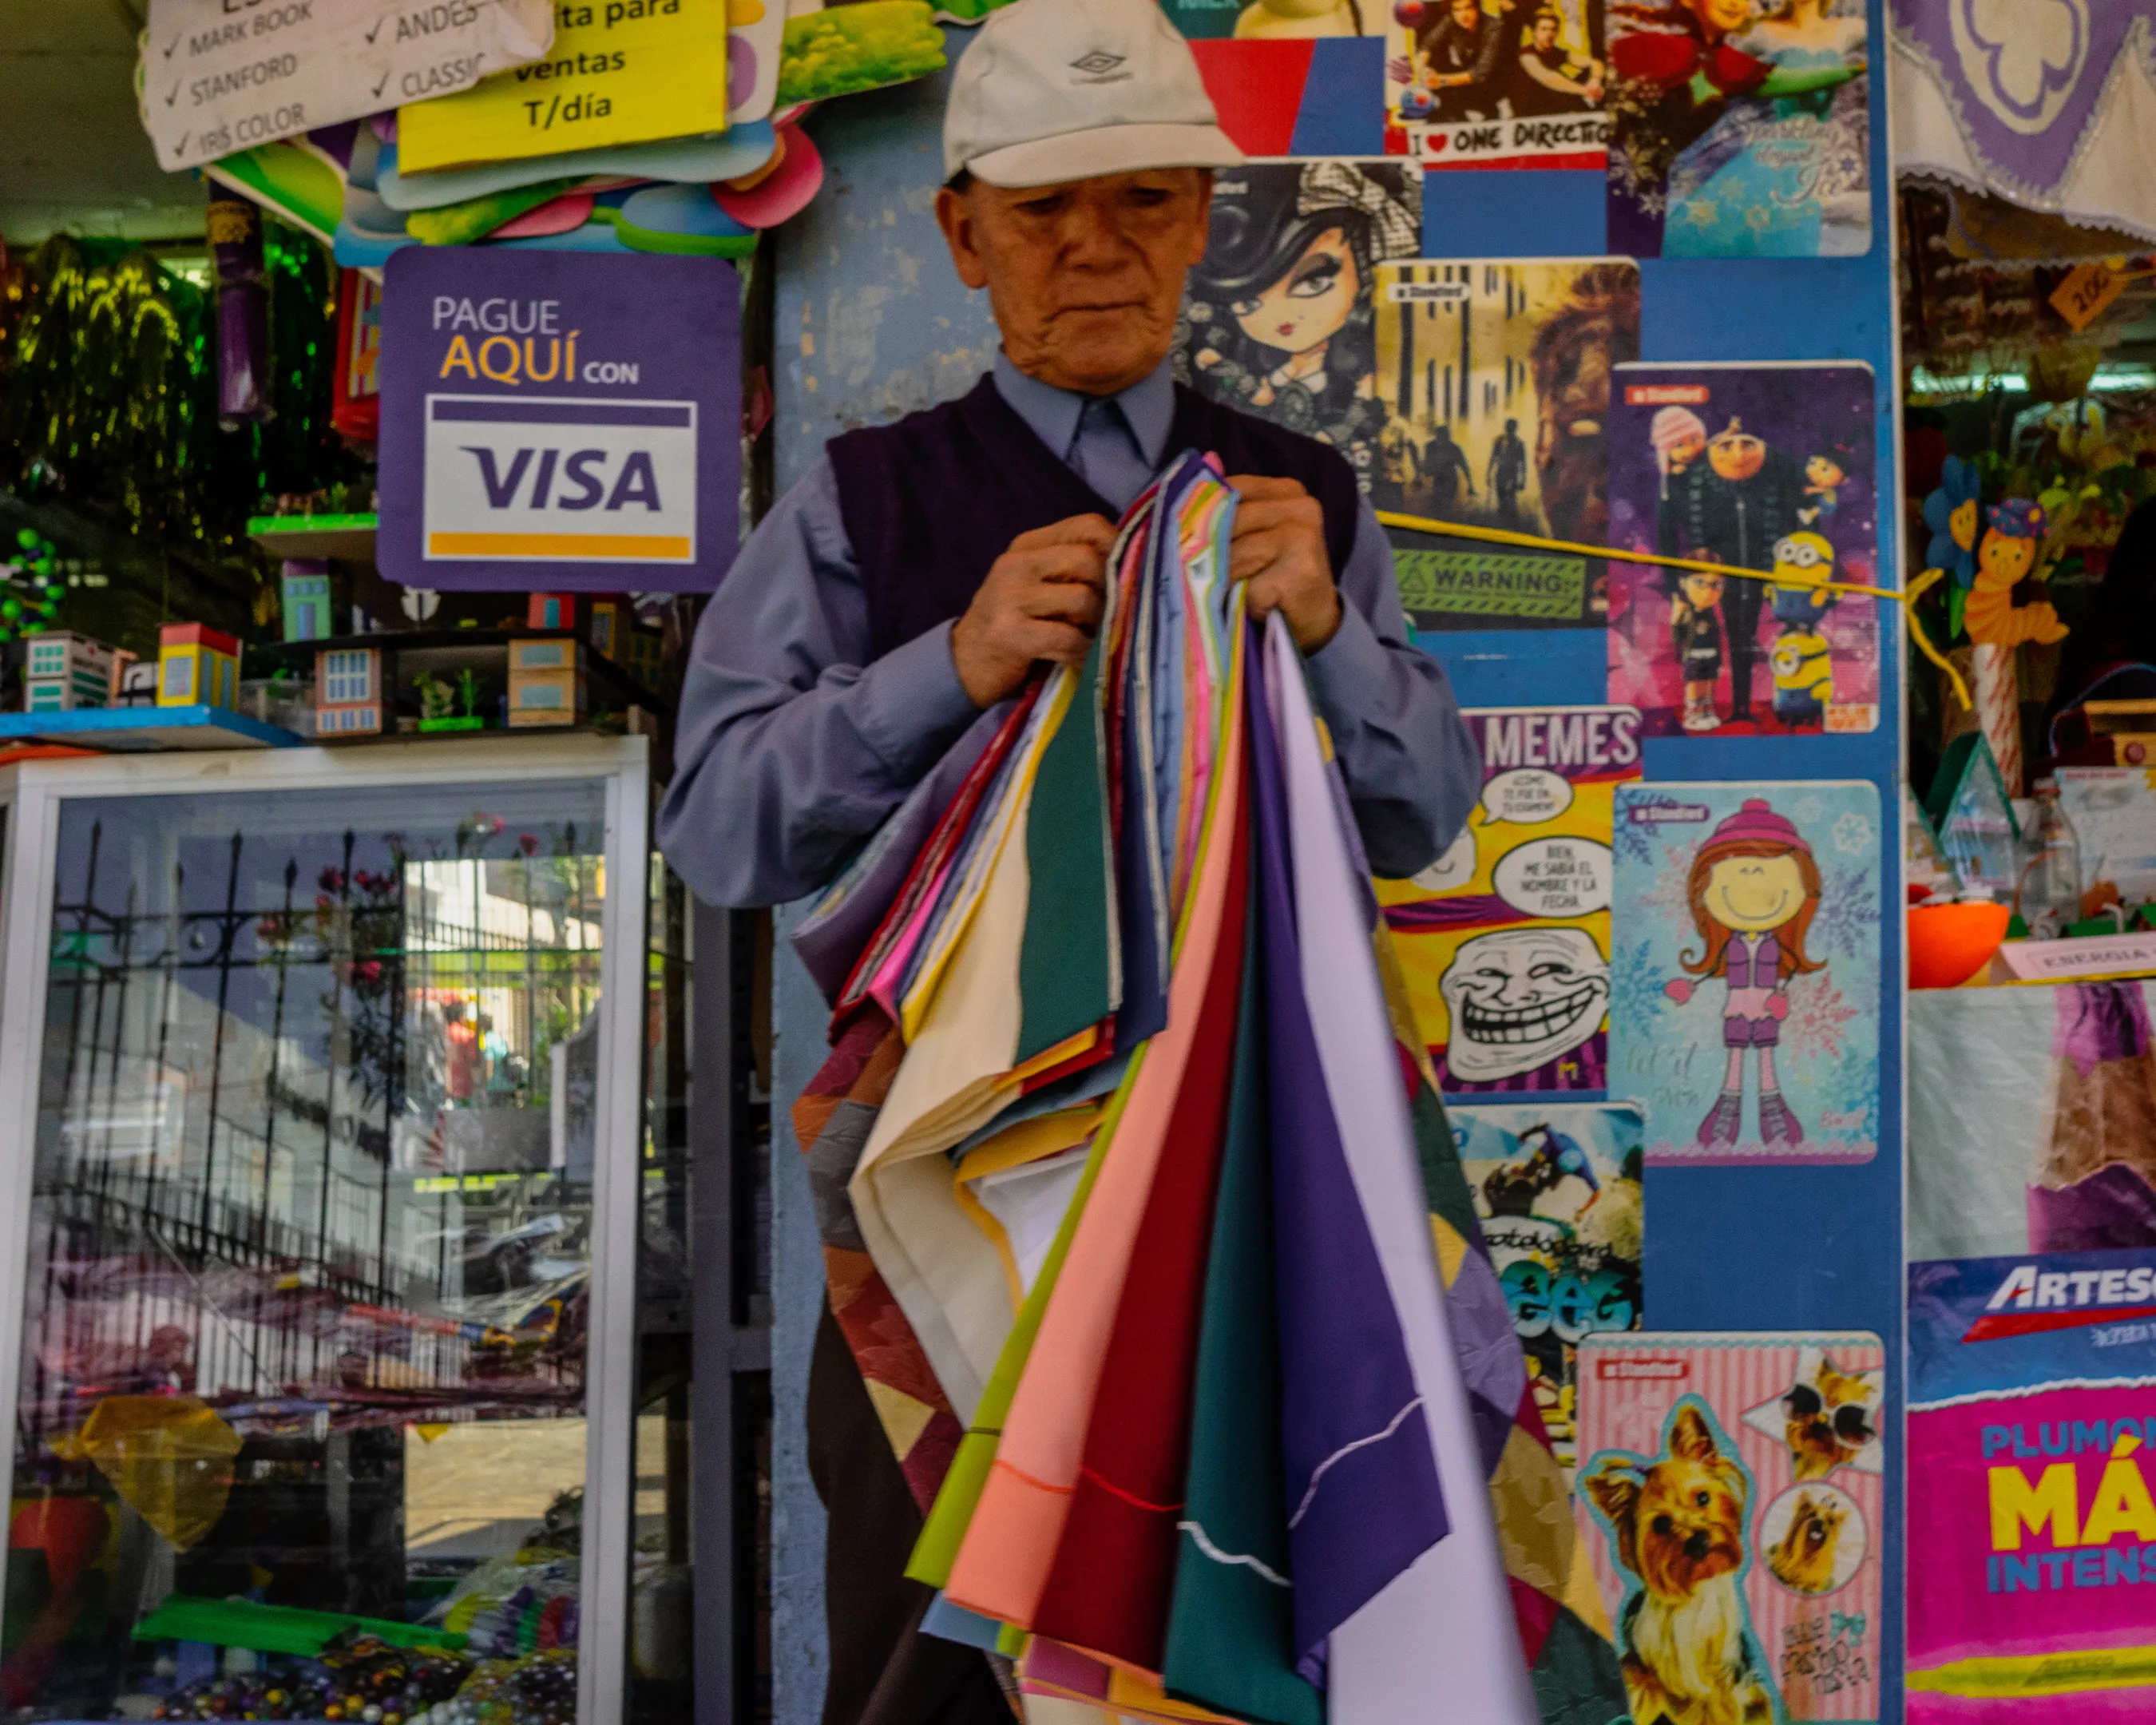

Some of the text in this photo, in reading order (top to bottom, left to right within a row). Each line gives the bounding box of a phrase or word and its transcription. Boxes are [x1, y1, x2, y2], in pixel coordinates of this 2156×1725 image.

[189, 21, 248, 57] MARK
[254, 2, 312, 37] BOOK
[190, 53, 297, 106] STANFORD
[515, 50, 627, 82] ventas
[236, 102, 305, 143] COLOR
[523, 92, 612, 131] T/día
[1412, 133, 1422, 156] I
[1453, 126, 1504, 152] ONE
[432, 295, 560, 335] PAGUE
[440, 329, 638, 387] AQUÍ CON
[458, 445, 663, 513] VISA
[1435, 568, 1562, 593] WARNING
[1484, 713, 1639, 767] MEMES
[1984, 1264, 2156, 1311] ARTES
